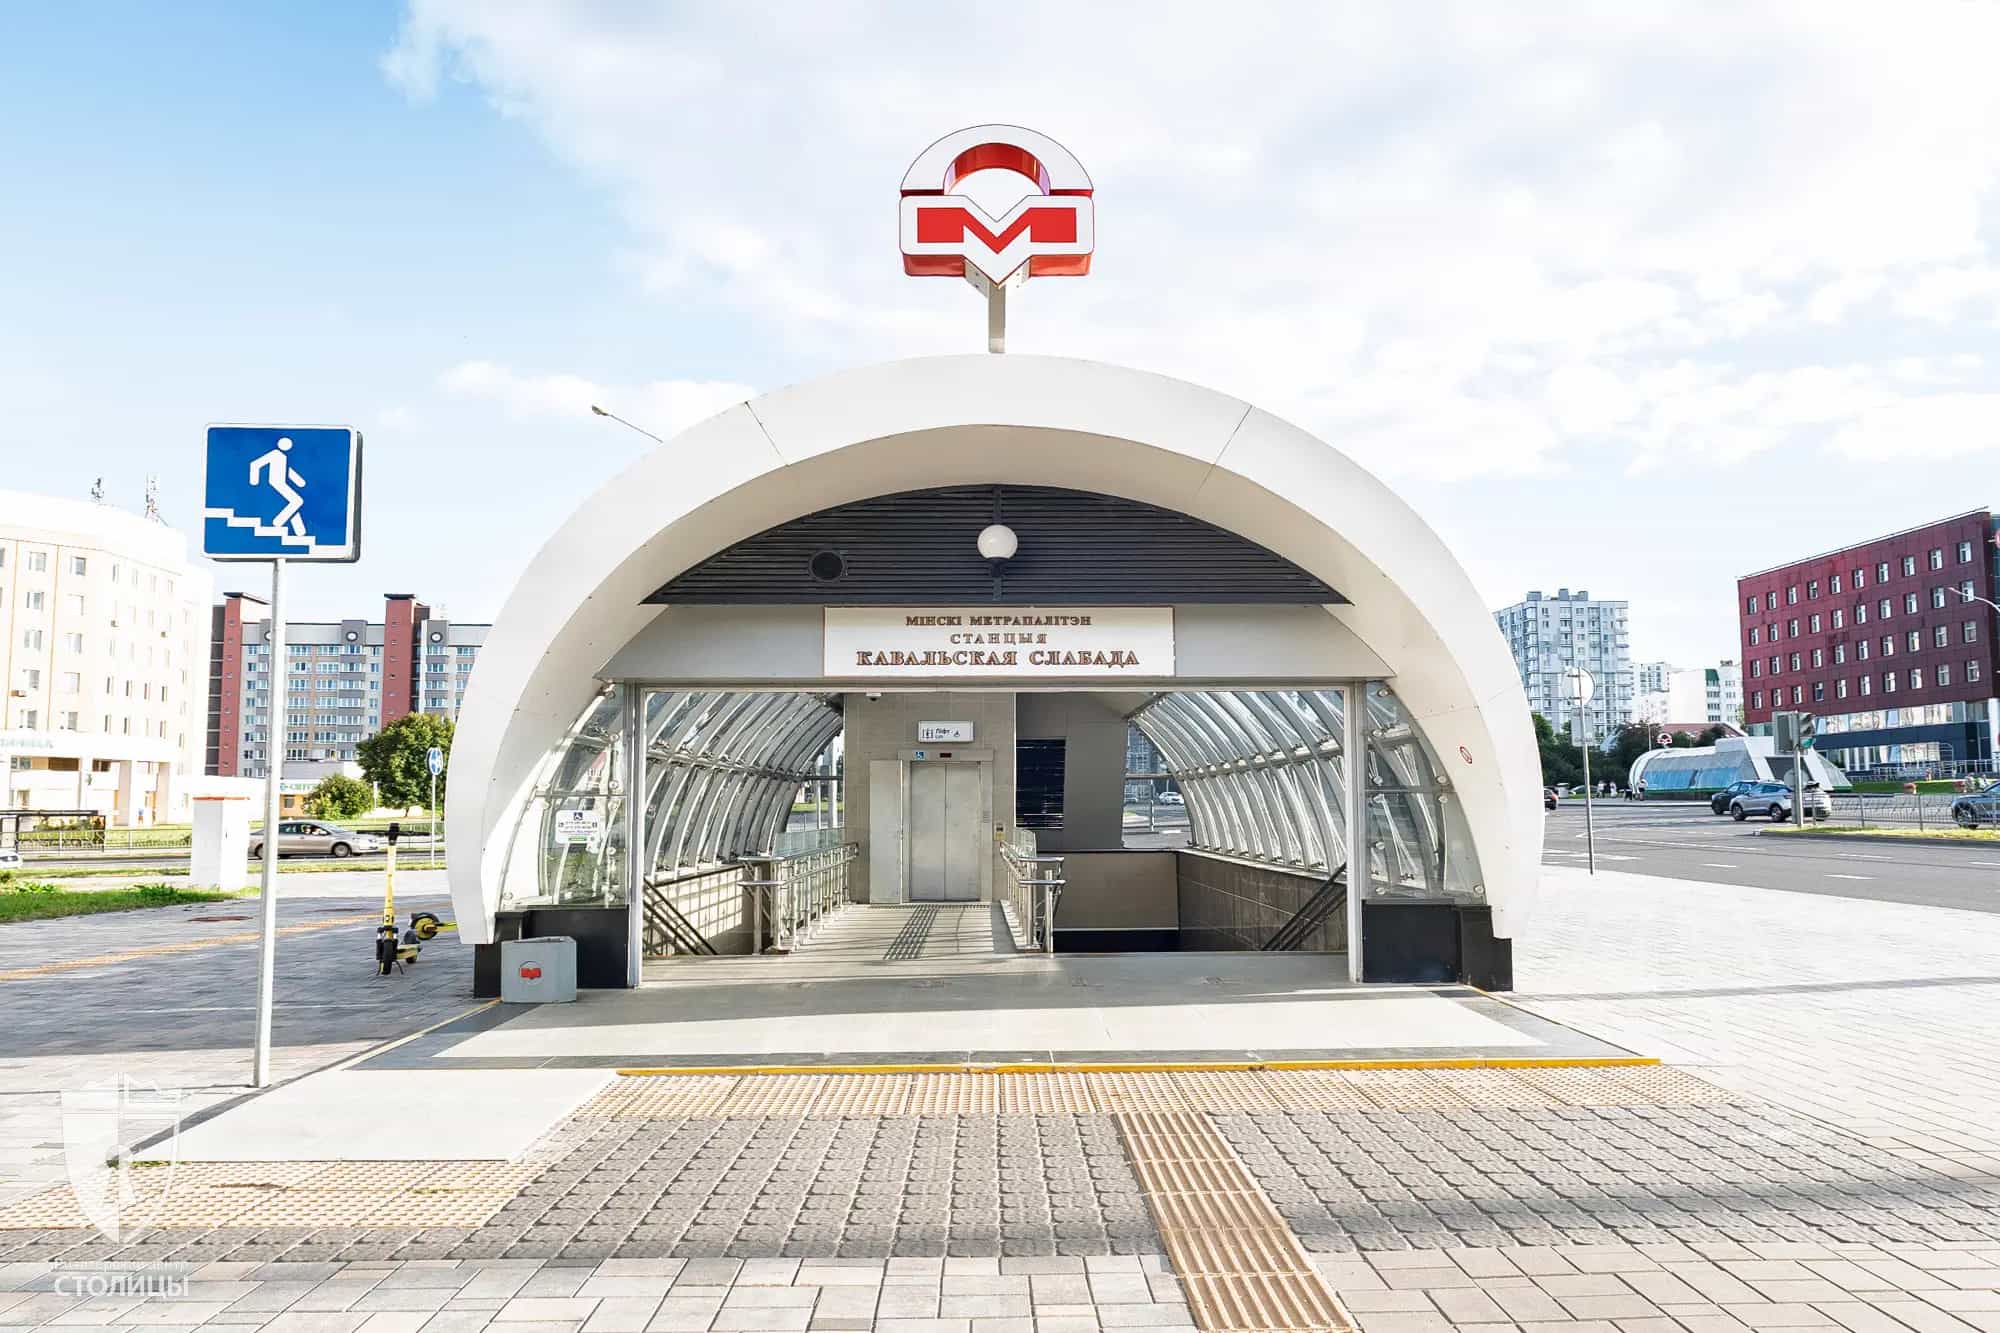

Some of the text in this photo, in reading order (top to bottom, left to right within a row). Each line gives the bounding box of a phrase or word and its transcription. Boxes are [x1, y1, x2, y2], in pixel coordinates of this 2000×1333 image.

[906, 616, 1092, 626] МІНСКІ МЕТРАПАЛІТЭН
[950, 633, 1047, 645] СТАНЦЫЯ
[856, 651, 1139, 668] КАВАЛЬСКАЯ СЛАБАДА
